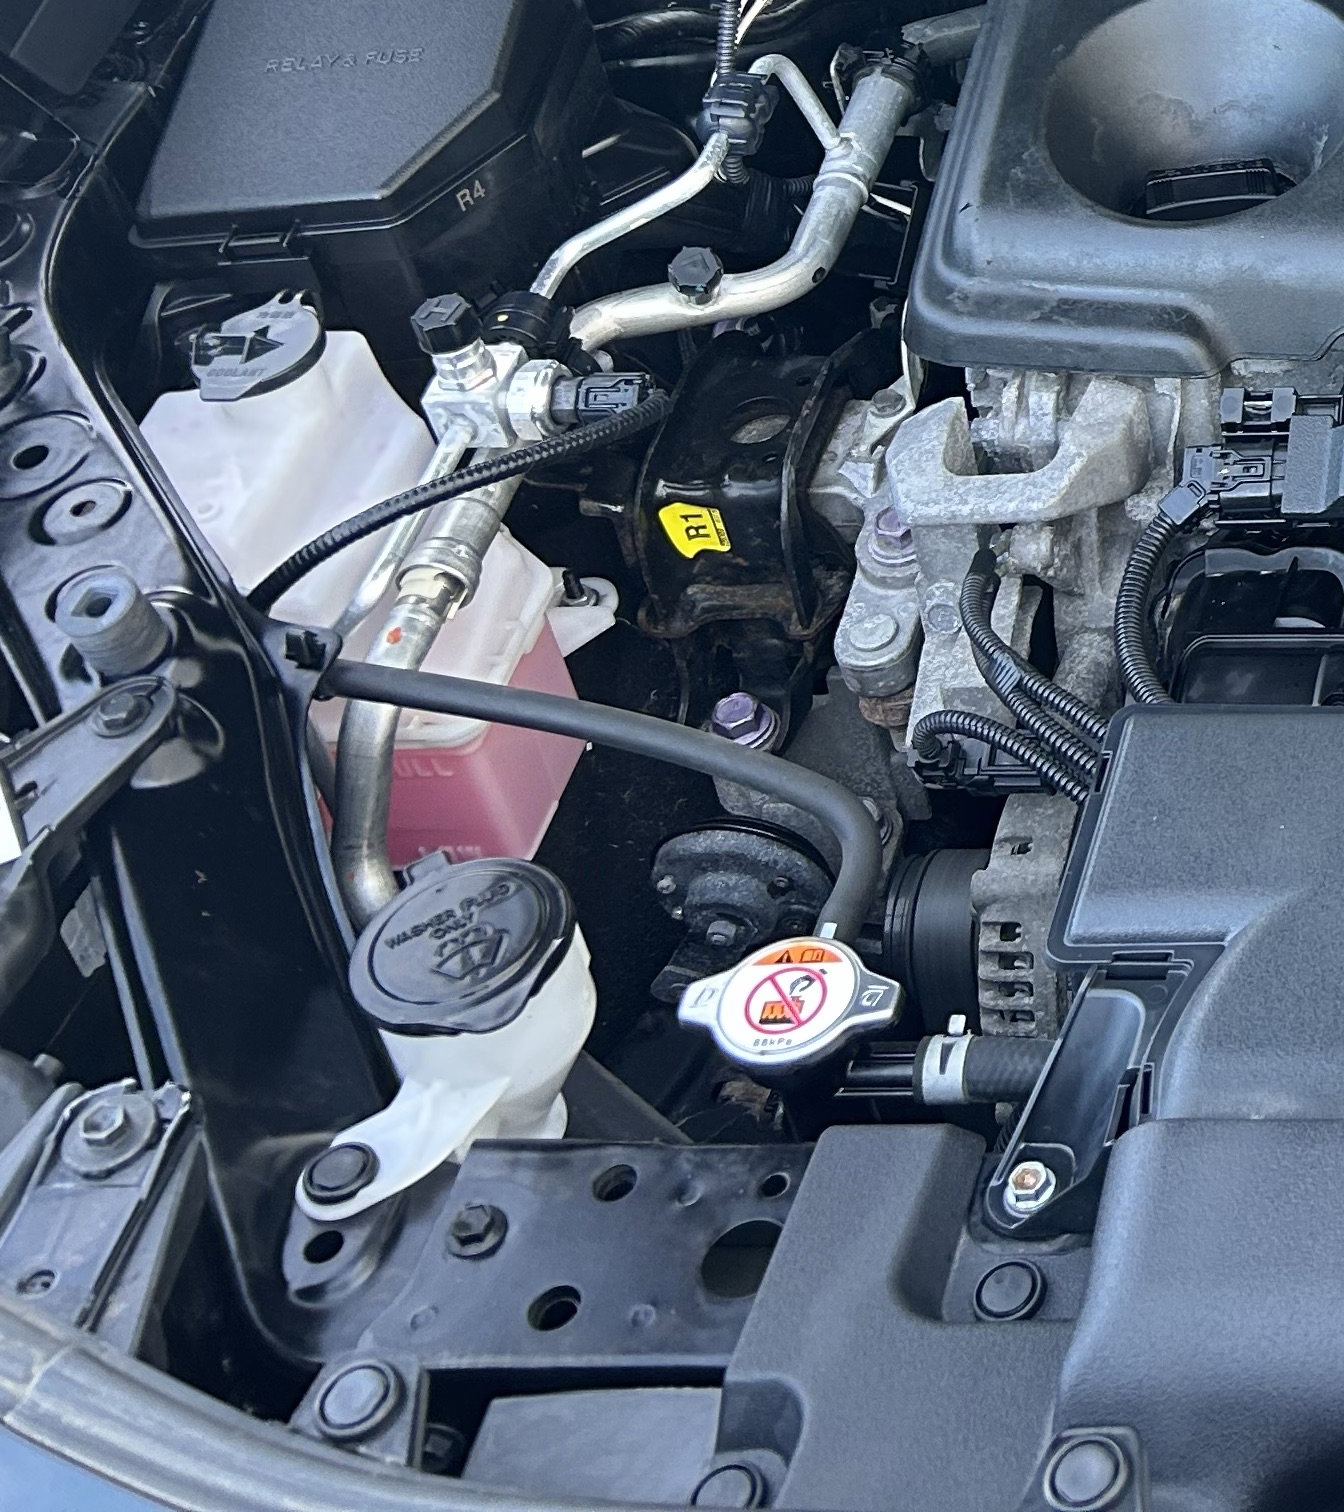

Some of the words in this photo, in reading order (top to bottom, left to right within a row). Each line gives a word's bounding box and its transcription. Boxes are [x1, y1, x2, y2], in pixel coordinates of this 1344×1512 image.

[264, 53, 341, 73] RELAY
[364, 47, 425, 65] FUSE
[455, 179, 486, 213] R4
[680, 513, 711, 541] R1
[384, 908, 457, 950] WASHER
